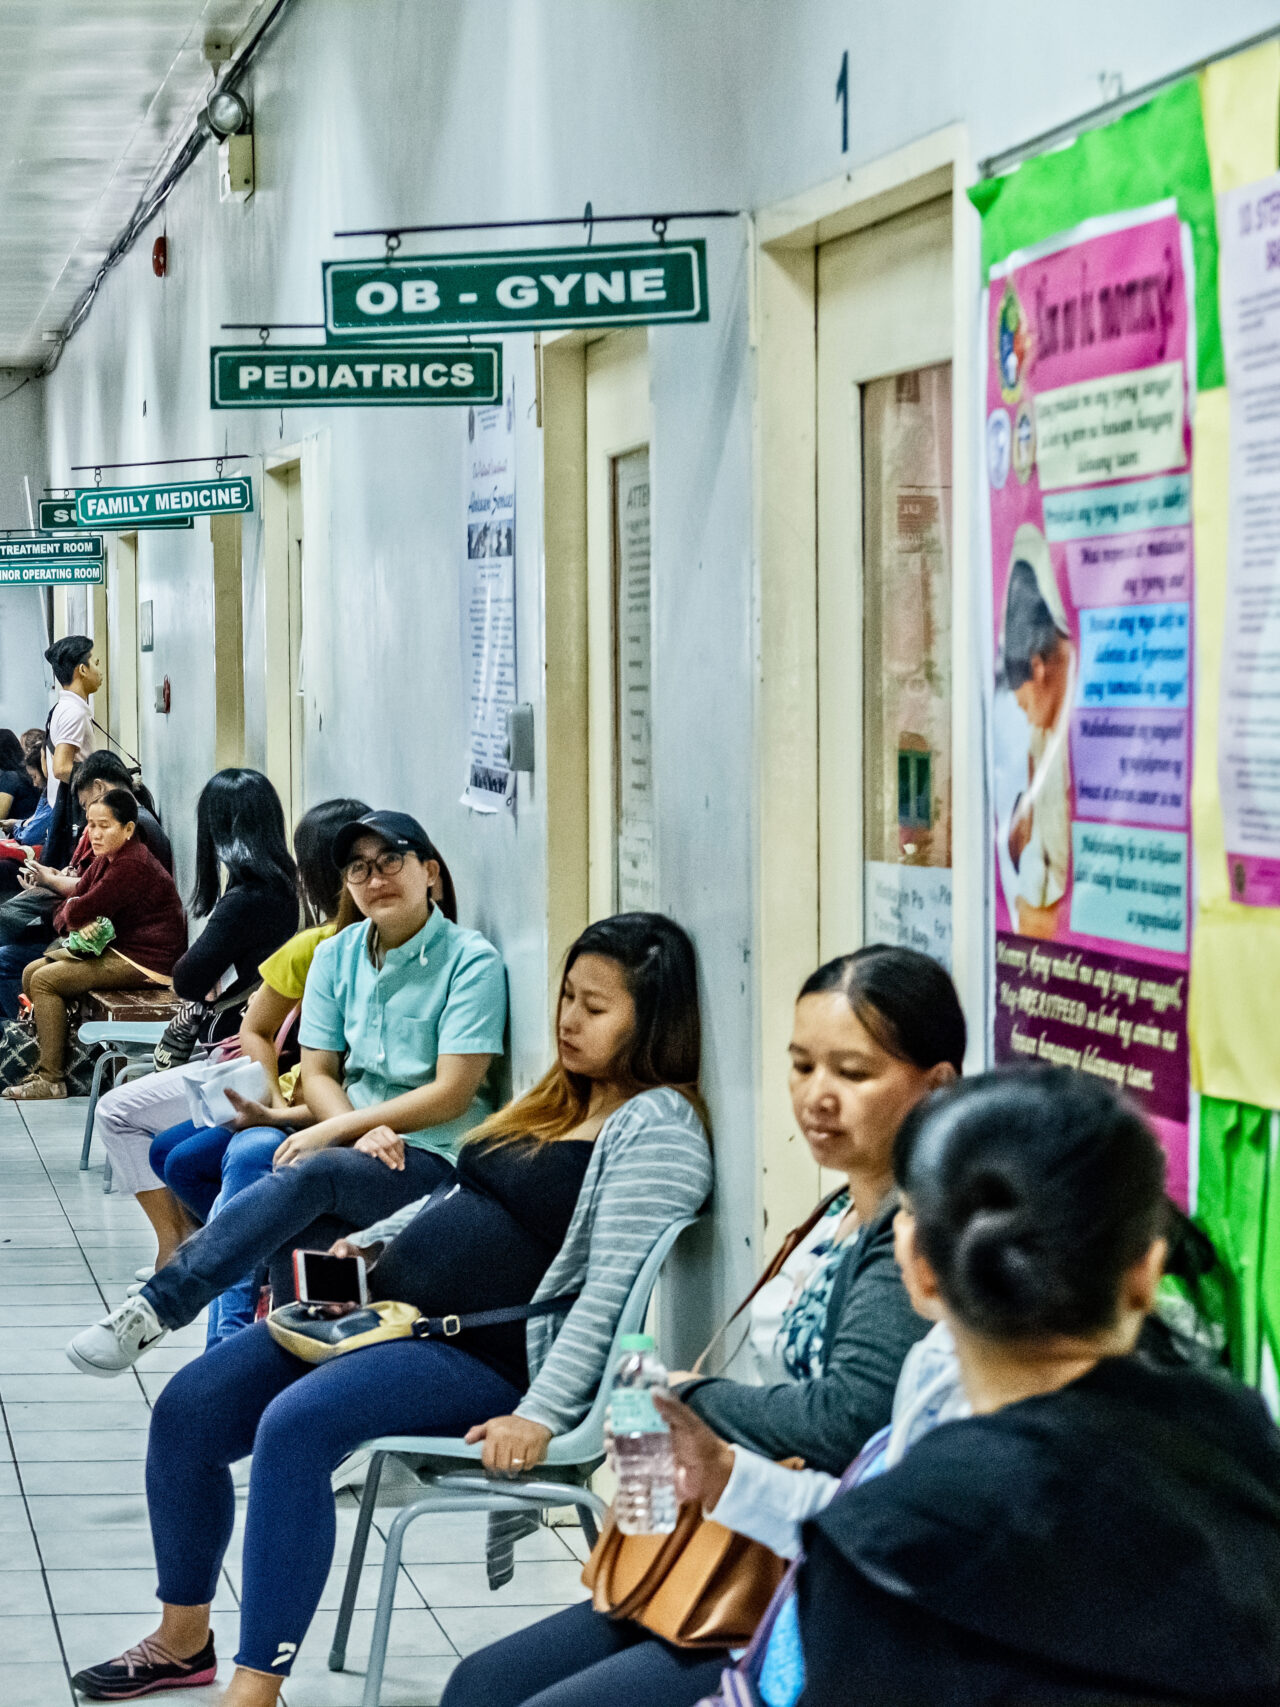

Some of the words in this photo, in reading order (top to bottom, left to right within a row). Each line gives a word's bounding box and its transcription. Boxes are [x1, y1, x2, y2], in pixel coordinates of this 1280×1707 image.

[356, 280, 440, 314] OB
[459, 293, 477, 303] -
[496, 268, 666, 308] GYNE
[239, 363, 474, 389] PEDIATRICS
[87, 495, 149, 516] FAMILY
[155, 486, 242, 511] MEDICINE
[0, 543, 60, 556] TREATMENT
[63, 541, 93, 553] ROOM
[22, 568, 72, 580] OPERATING
[74, 567, 100, 579] ROOM
